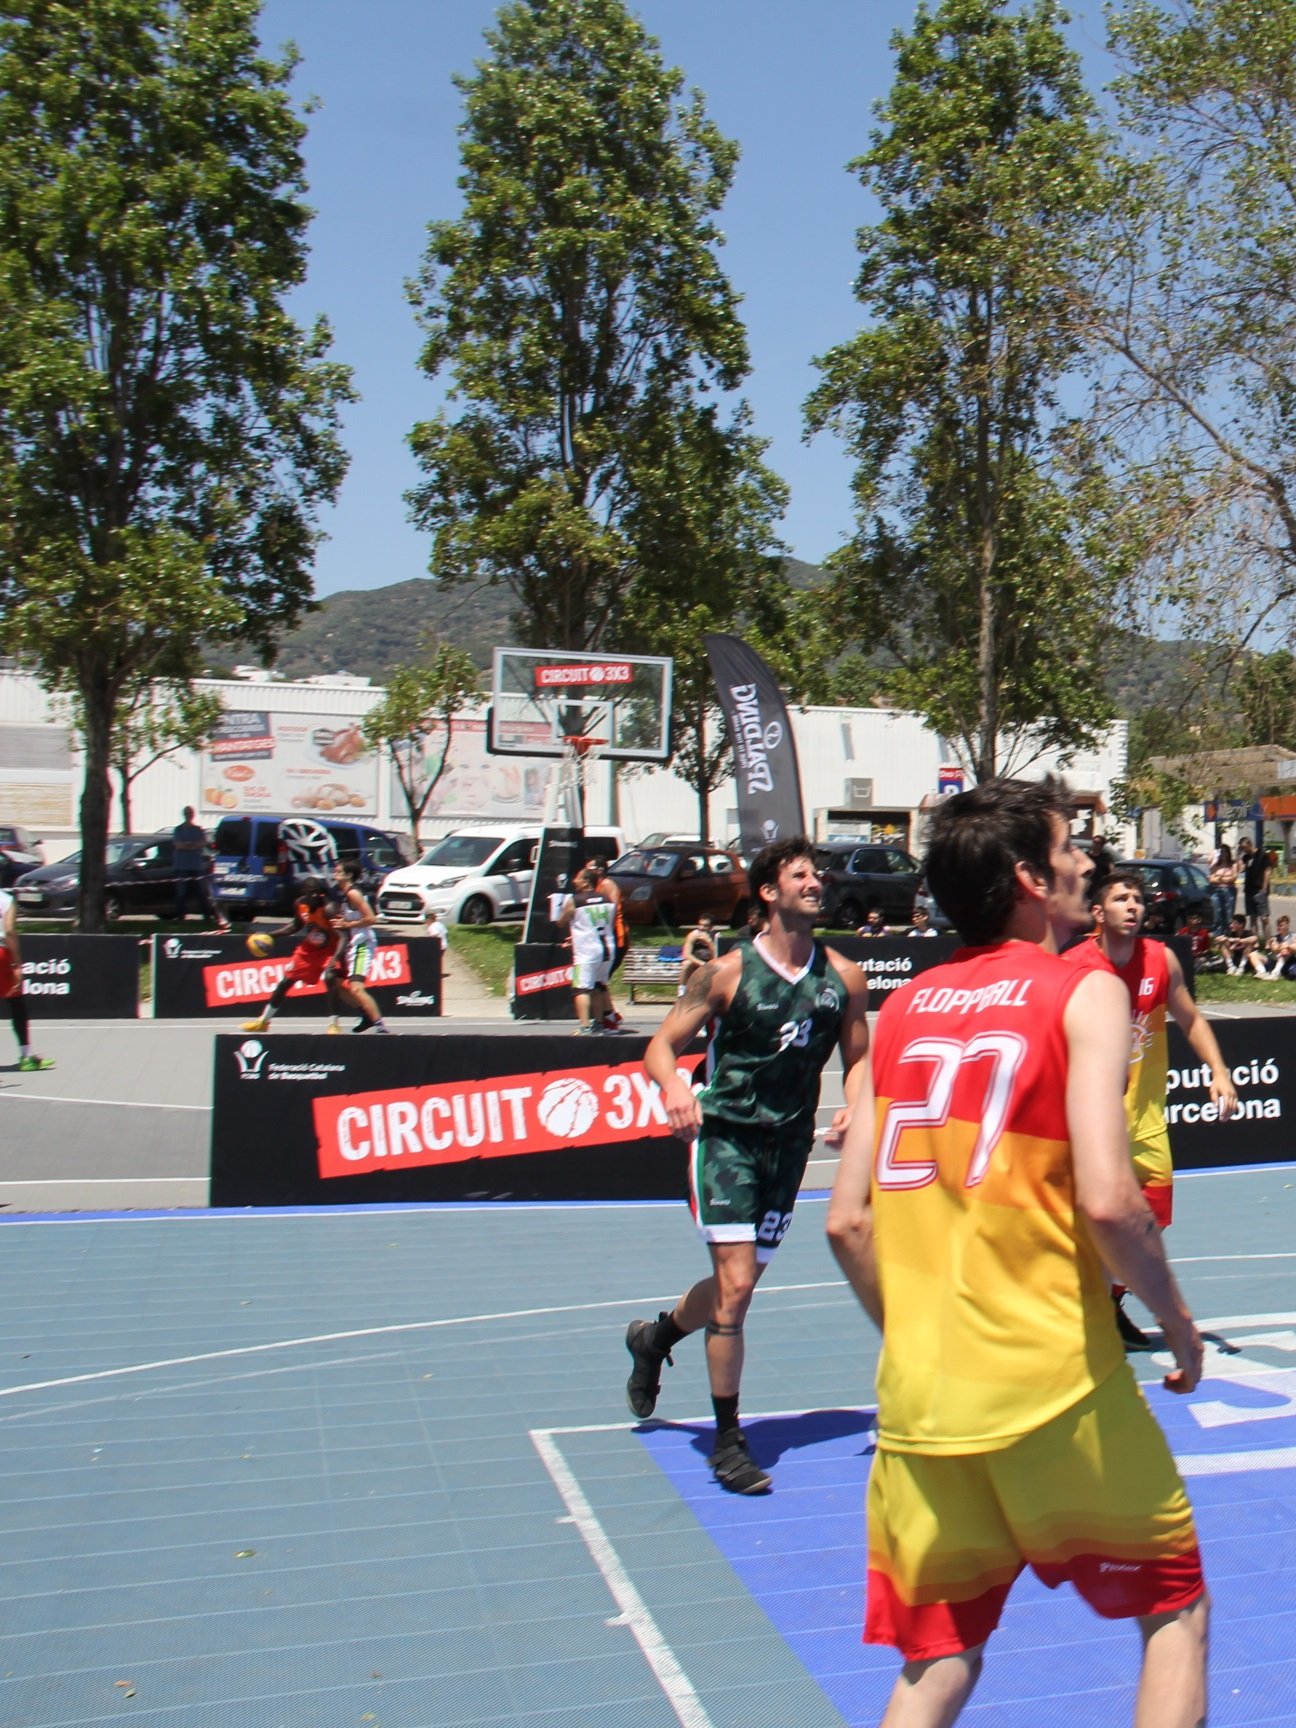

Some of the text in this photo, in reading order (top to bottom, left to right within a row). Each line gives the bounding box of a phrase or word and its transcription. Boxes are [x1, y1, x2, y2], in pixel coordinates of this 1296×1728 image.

[541, 665, 630, 684] CIRCUIT 3X3
[520, 968, 566, 992] CIRCUIT
[1138, 977, 1155, 996] 16
[1166, 1057, 1280, 1096] putció
[336, 1085, 534, 1163] CIRCUIT
[877, 1030, 1028, 1191] 27
[1164, 1095, 1282, 1124] rcelona
[757, 1210, 793, 1243] 23
